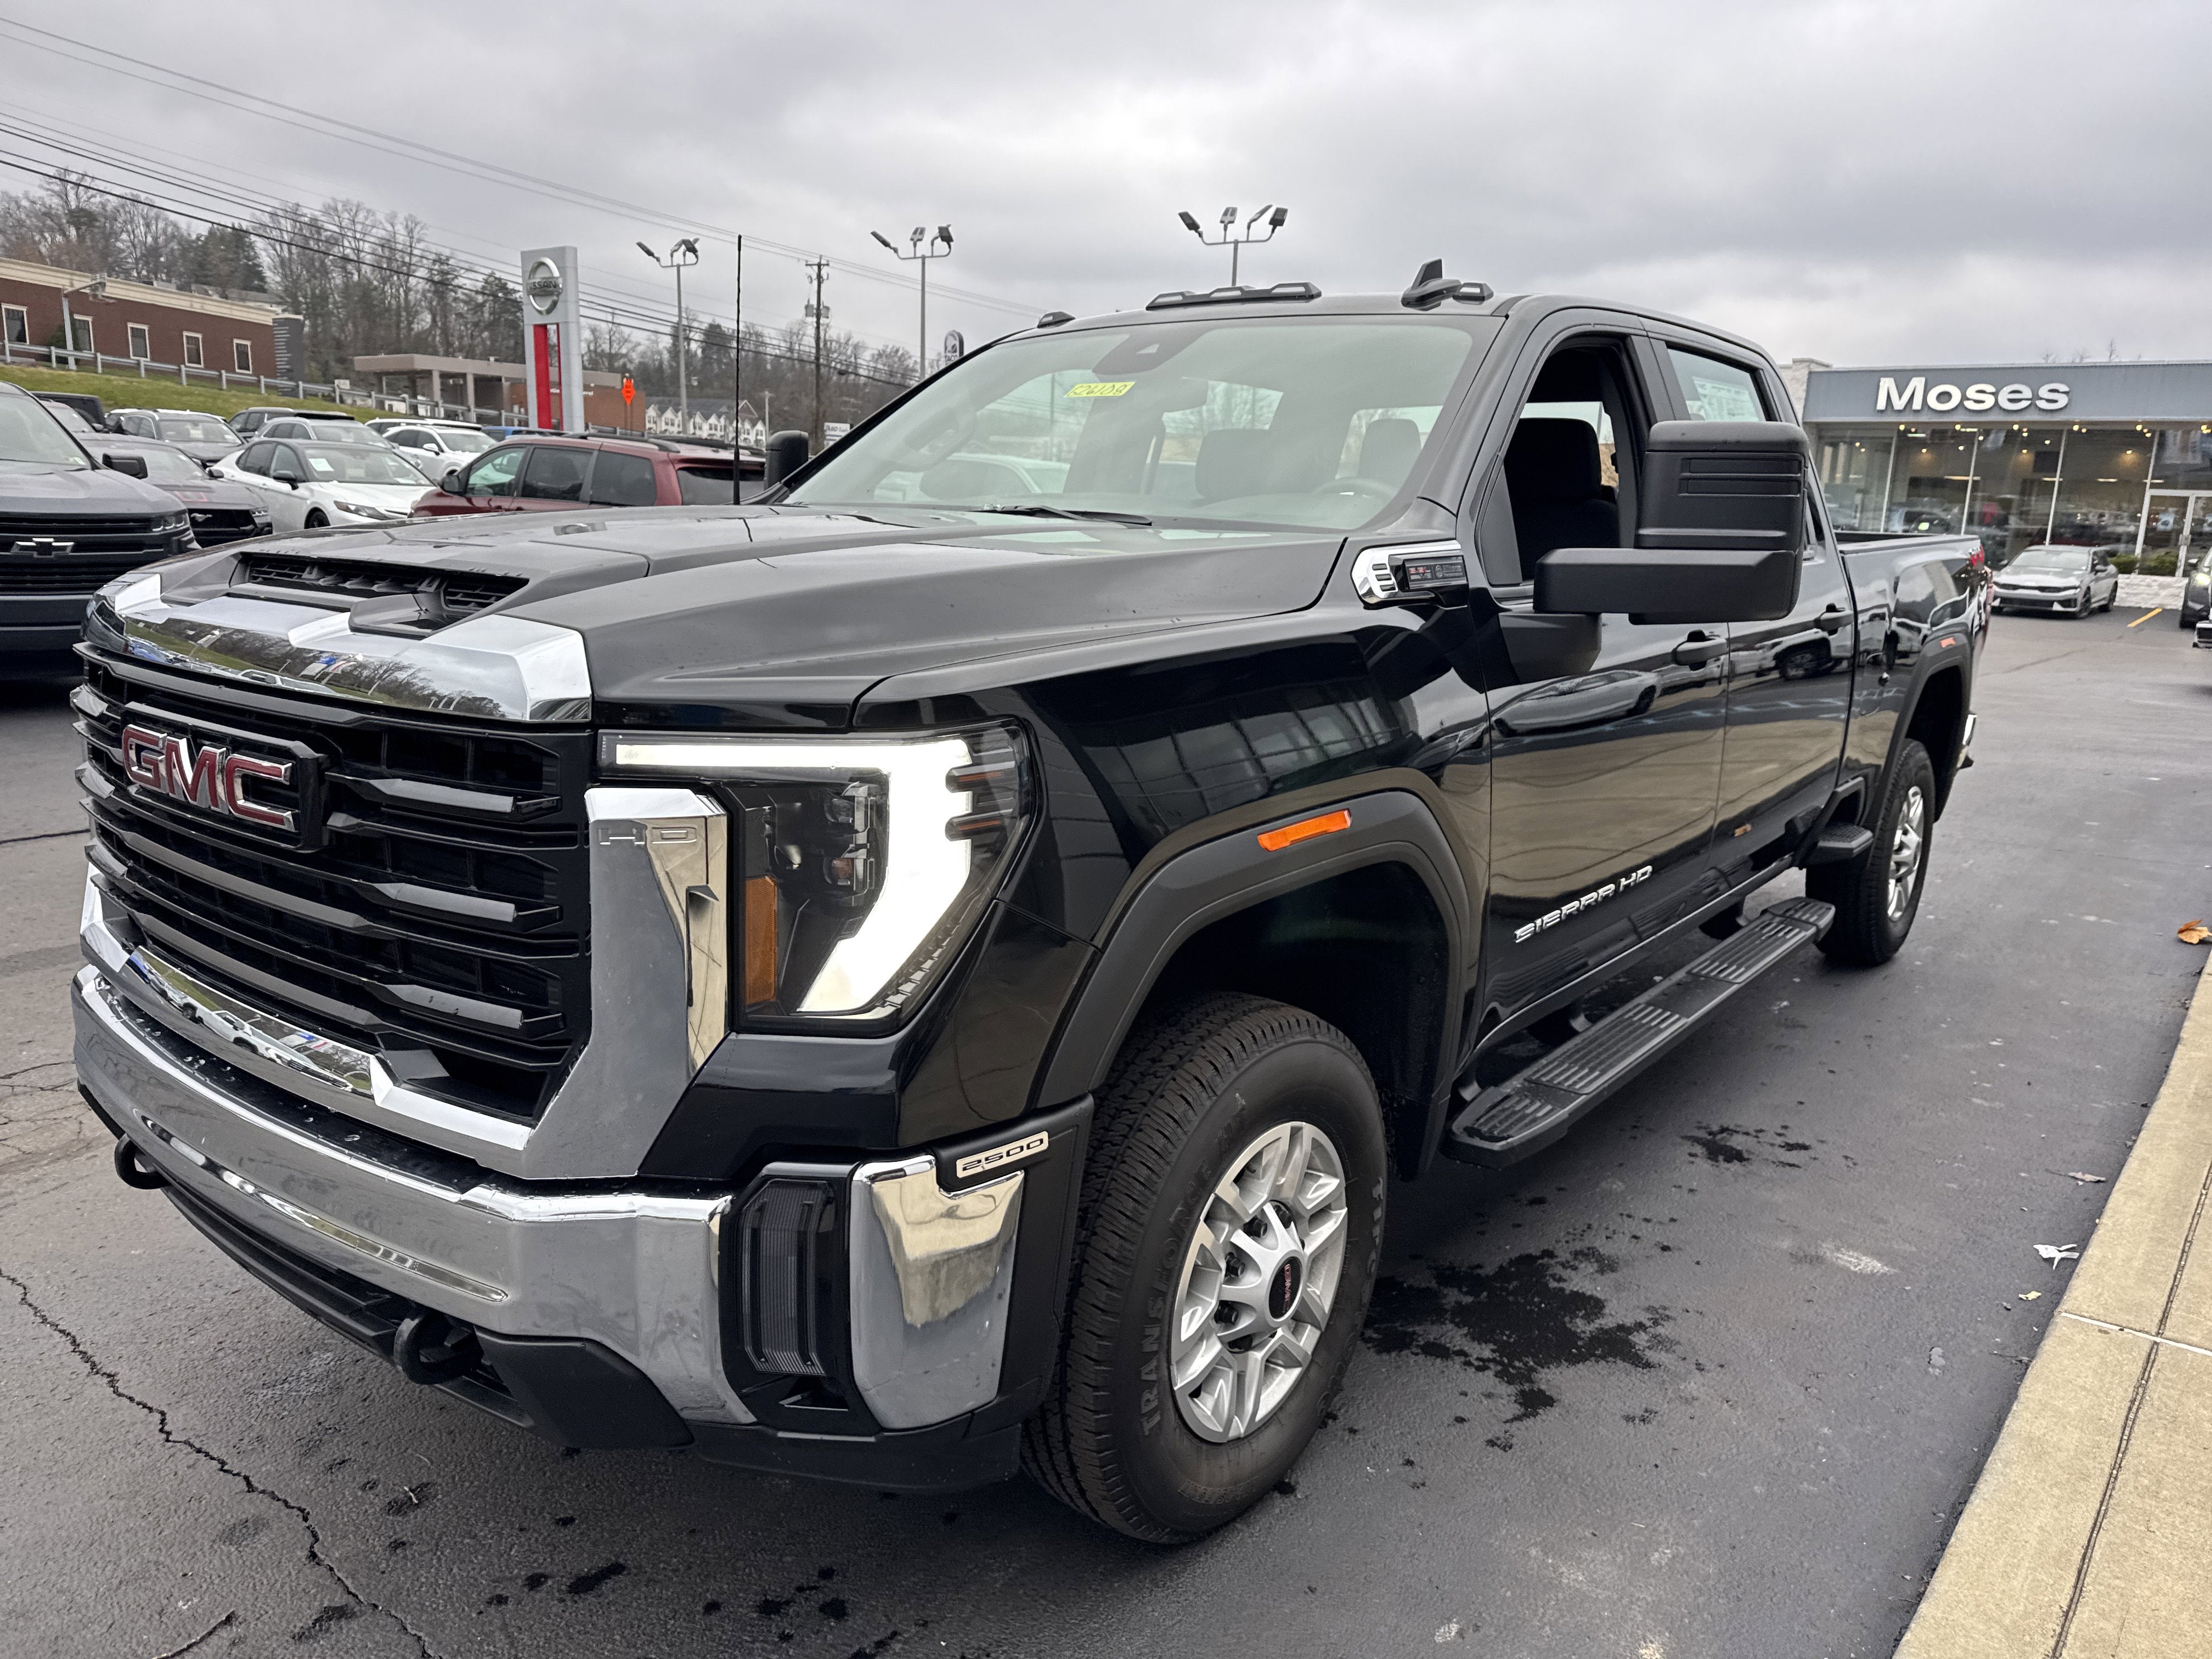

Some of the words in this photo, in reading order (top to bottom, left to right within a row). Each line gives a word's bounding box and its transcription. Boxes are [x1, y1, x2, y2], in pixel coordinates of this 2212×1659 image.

[1876, 376, 2070, 411] Moses
[122, 724, 300, 833] GMC
[1514, 883, 1616, 944] SIERRA
[1619, 865, 1653, 893] HD
[962, 1138, 1044, 1172] 2500
